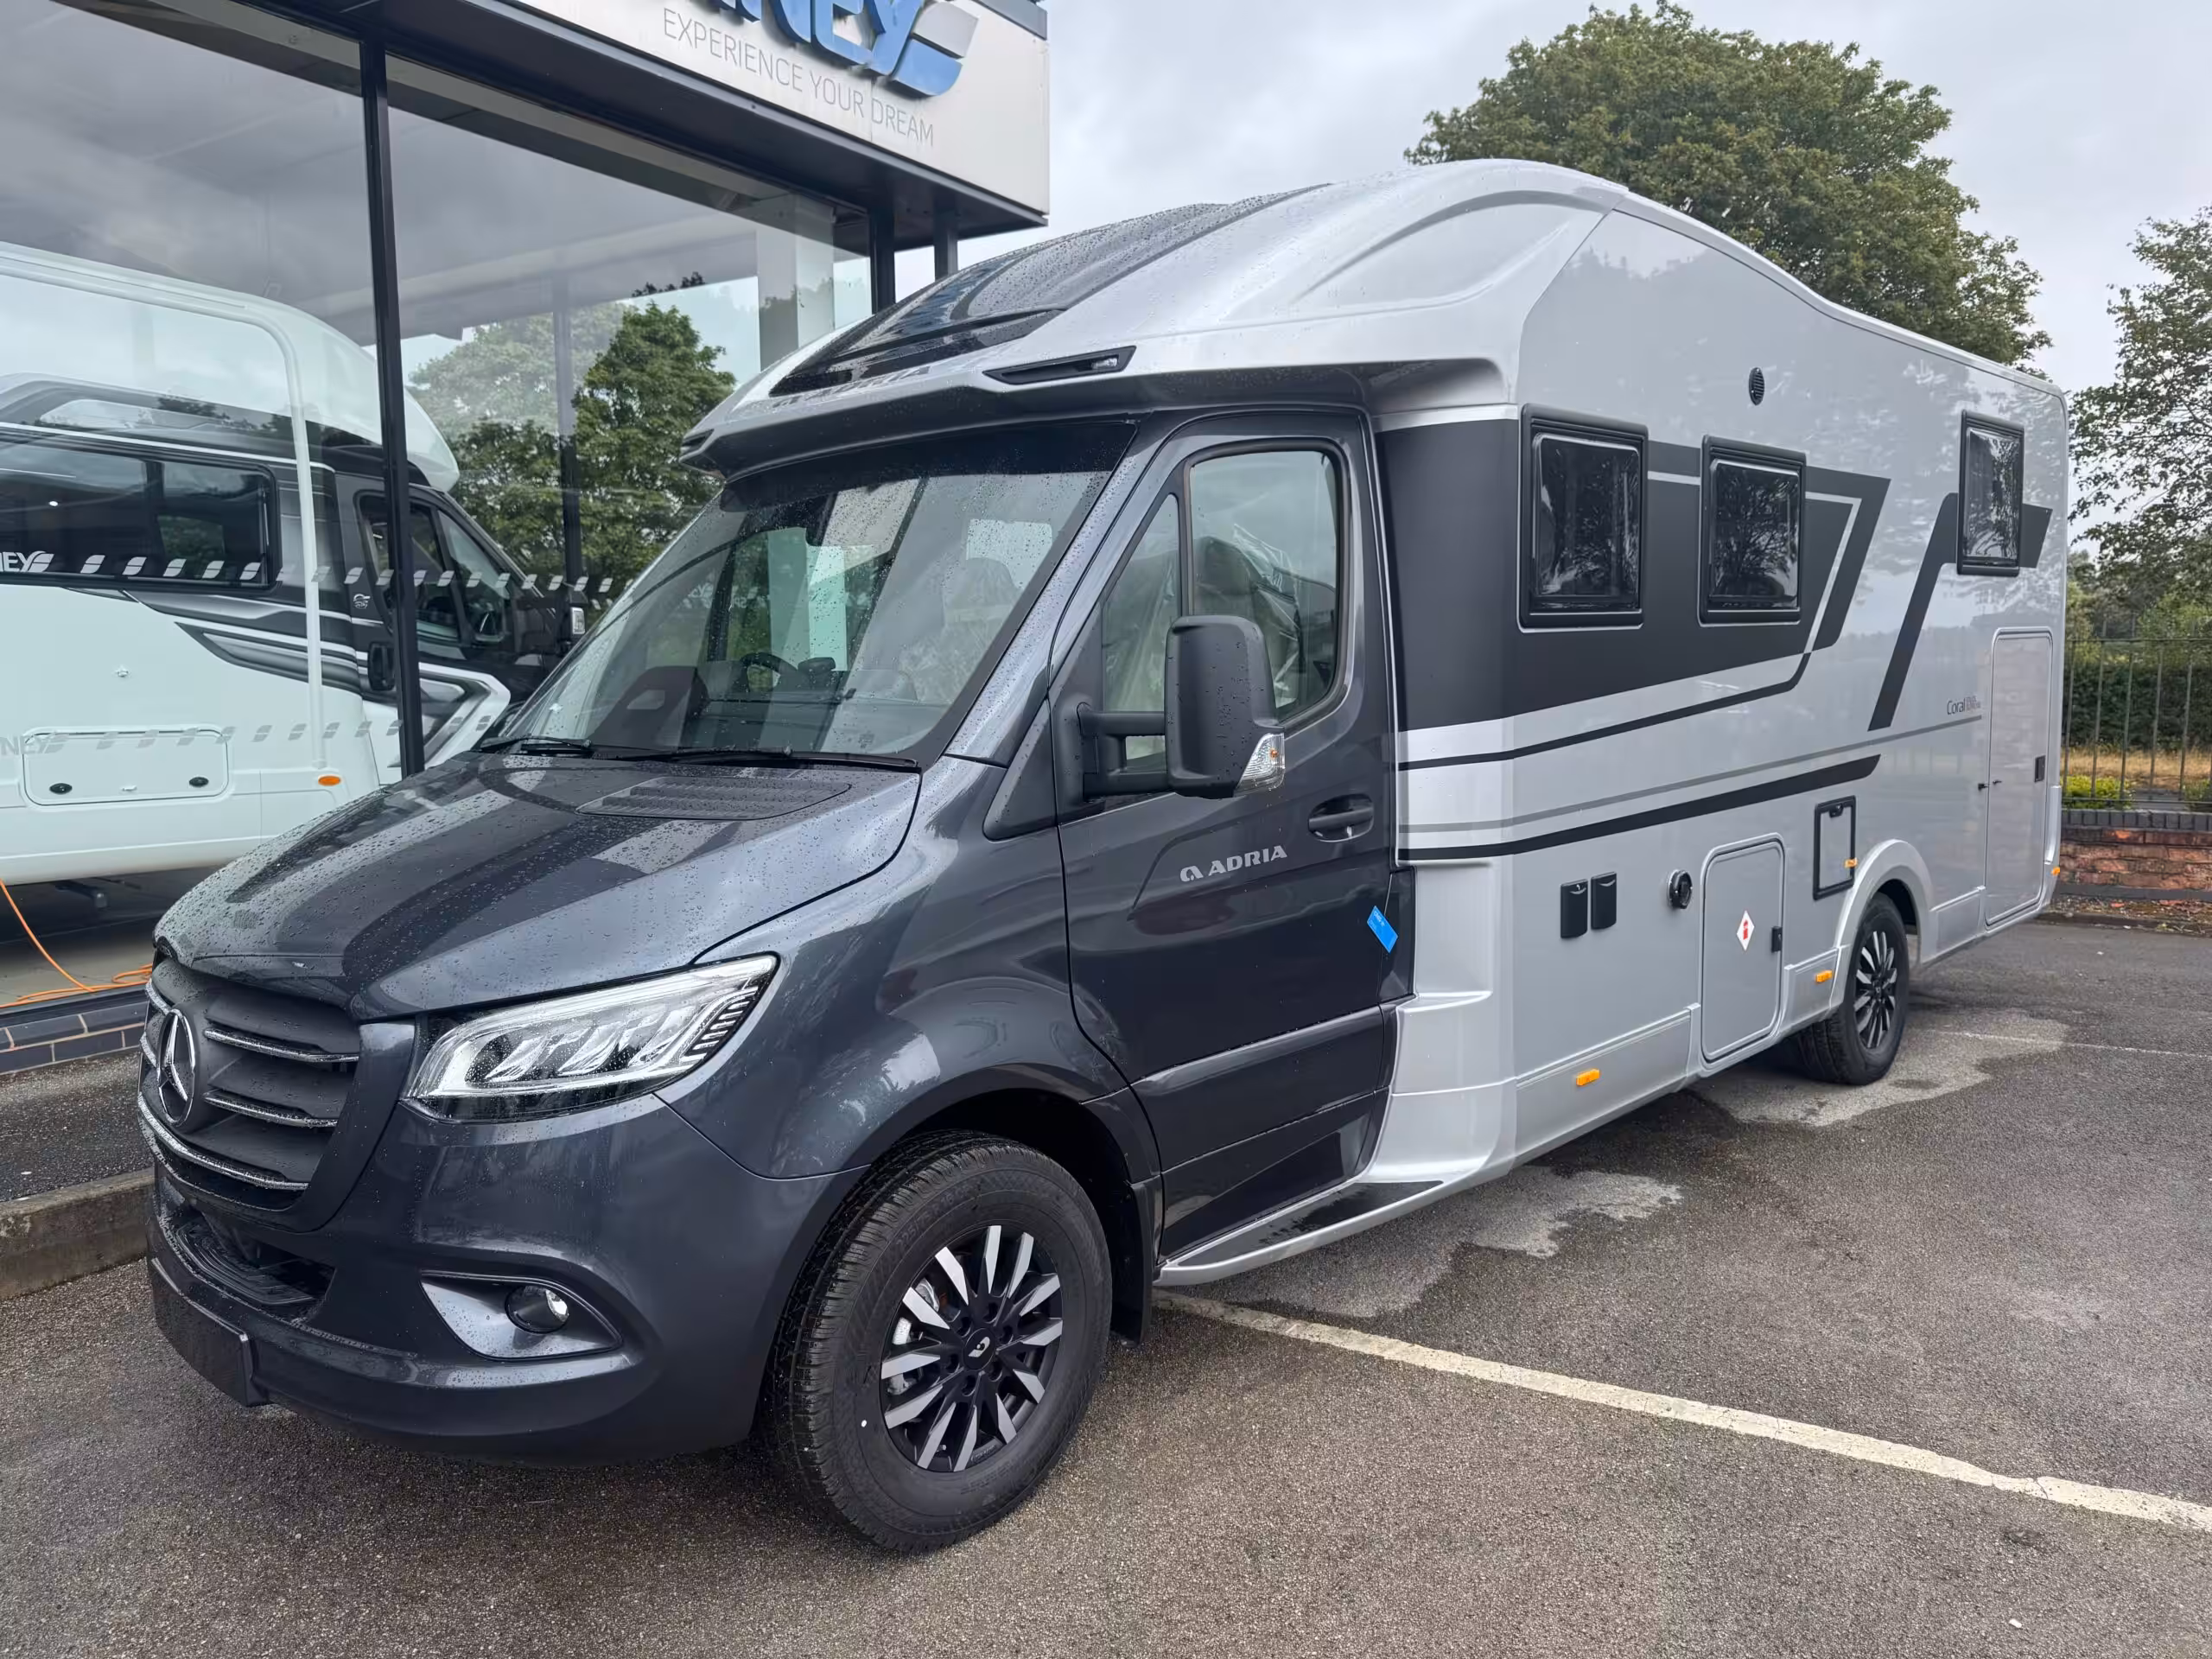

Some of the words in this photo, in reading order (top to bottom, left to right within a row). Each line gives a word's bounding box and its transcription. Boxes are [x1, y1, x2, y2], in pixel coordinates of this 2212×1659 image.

[664, 8, 803, 92] EXPERIENCE
[810, 70, 865, 118] YOUR
[871, 97, 934, 147] DREAM
[0, 550, 46, 572] EY
[1947, 697, 1966, 715] Coral
[1208, 845, 1287, 876] ADRIA
